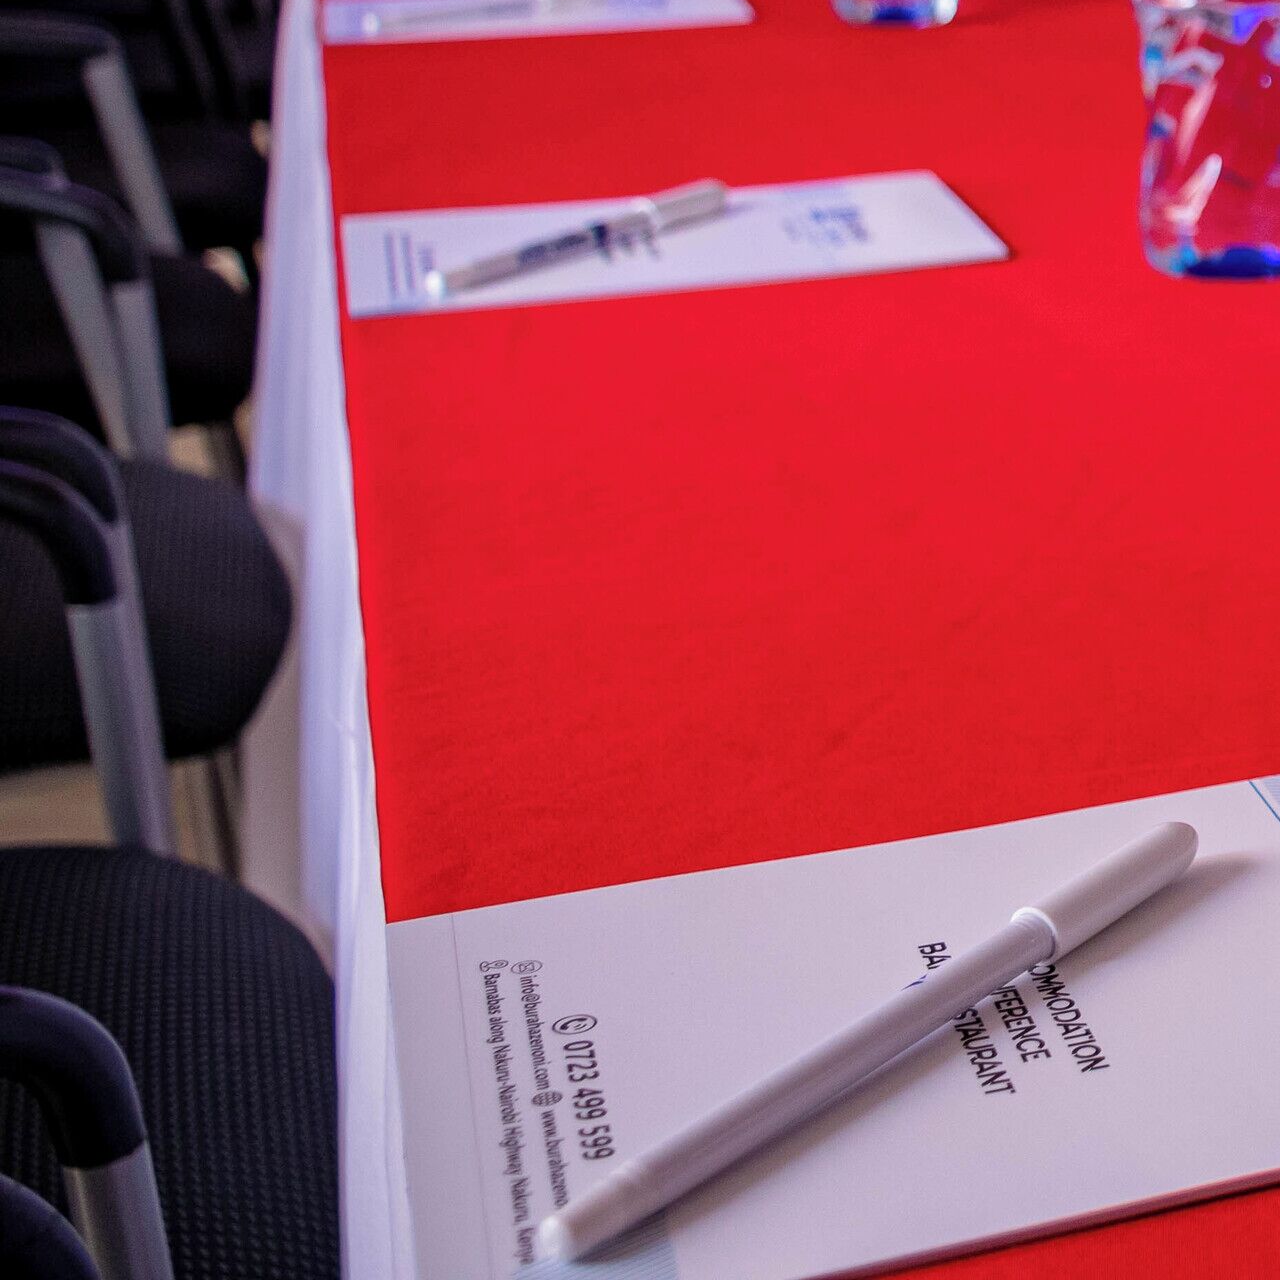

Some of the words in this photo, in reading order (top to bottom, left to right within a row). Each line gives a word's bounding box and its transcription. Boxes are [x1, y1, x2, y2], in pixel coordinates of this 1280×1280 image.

[483, 972, 505, 1015] Barnabas
[486, 1017, 507, 1044] along
[918, 941, 952, 970] BA
[953, 1007, 1017, 1095] STAURANT
[991, 985, 1052, 1063] FERENCE
[1030, 964, 1110, 1073] OMMODATION
[563, 1040, 600, 1083] 0723
[520, 974, 551, 1091] info@burahazenoni.com
[541, 1109, 570, 1208] www.burahazeno
[572, 1087, 607, 1121] 499
[499, 1126, 526, 1176] Highway
[578, 1124, 616, 1160] 599
